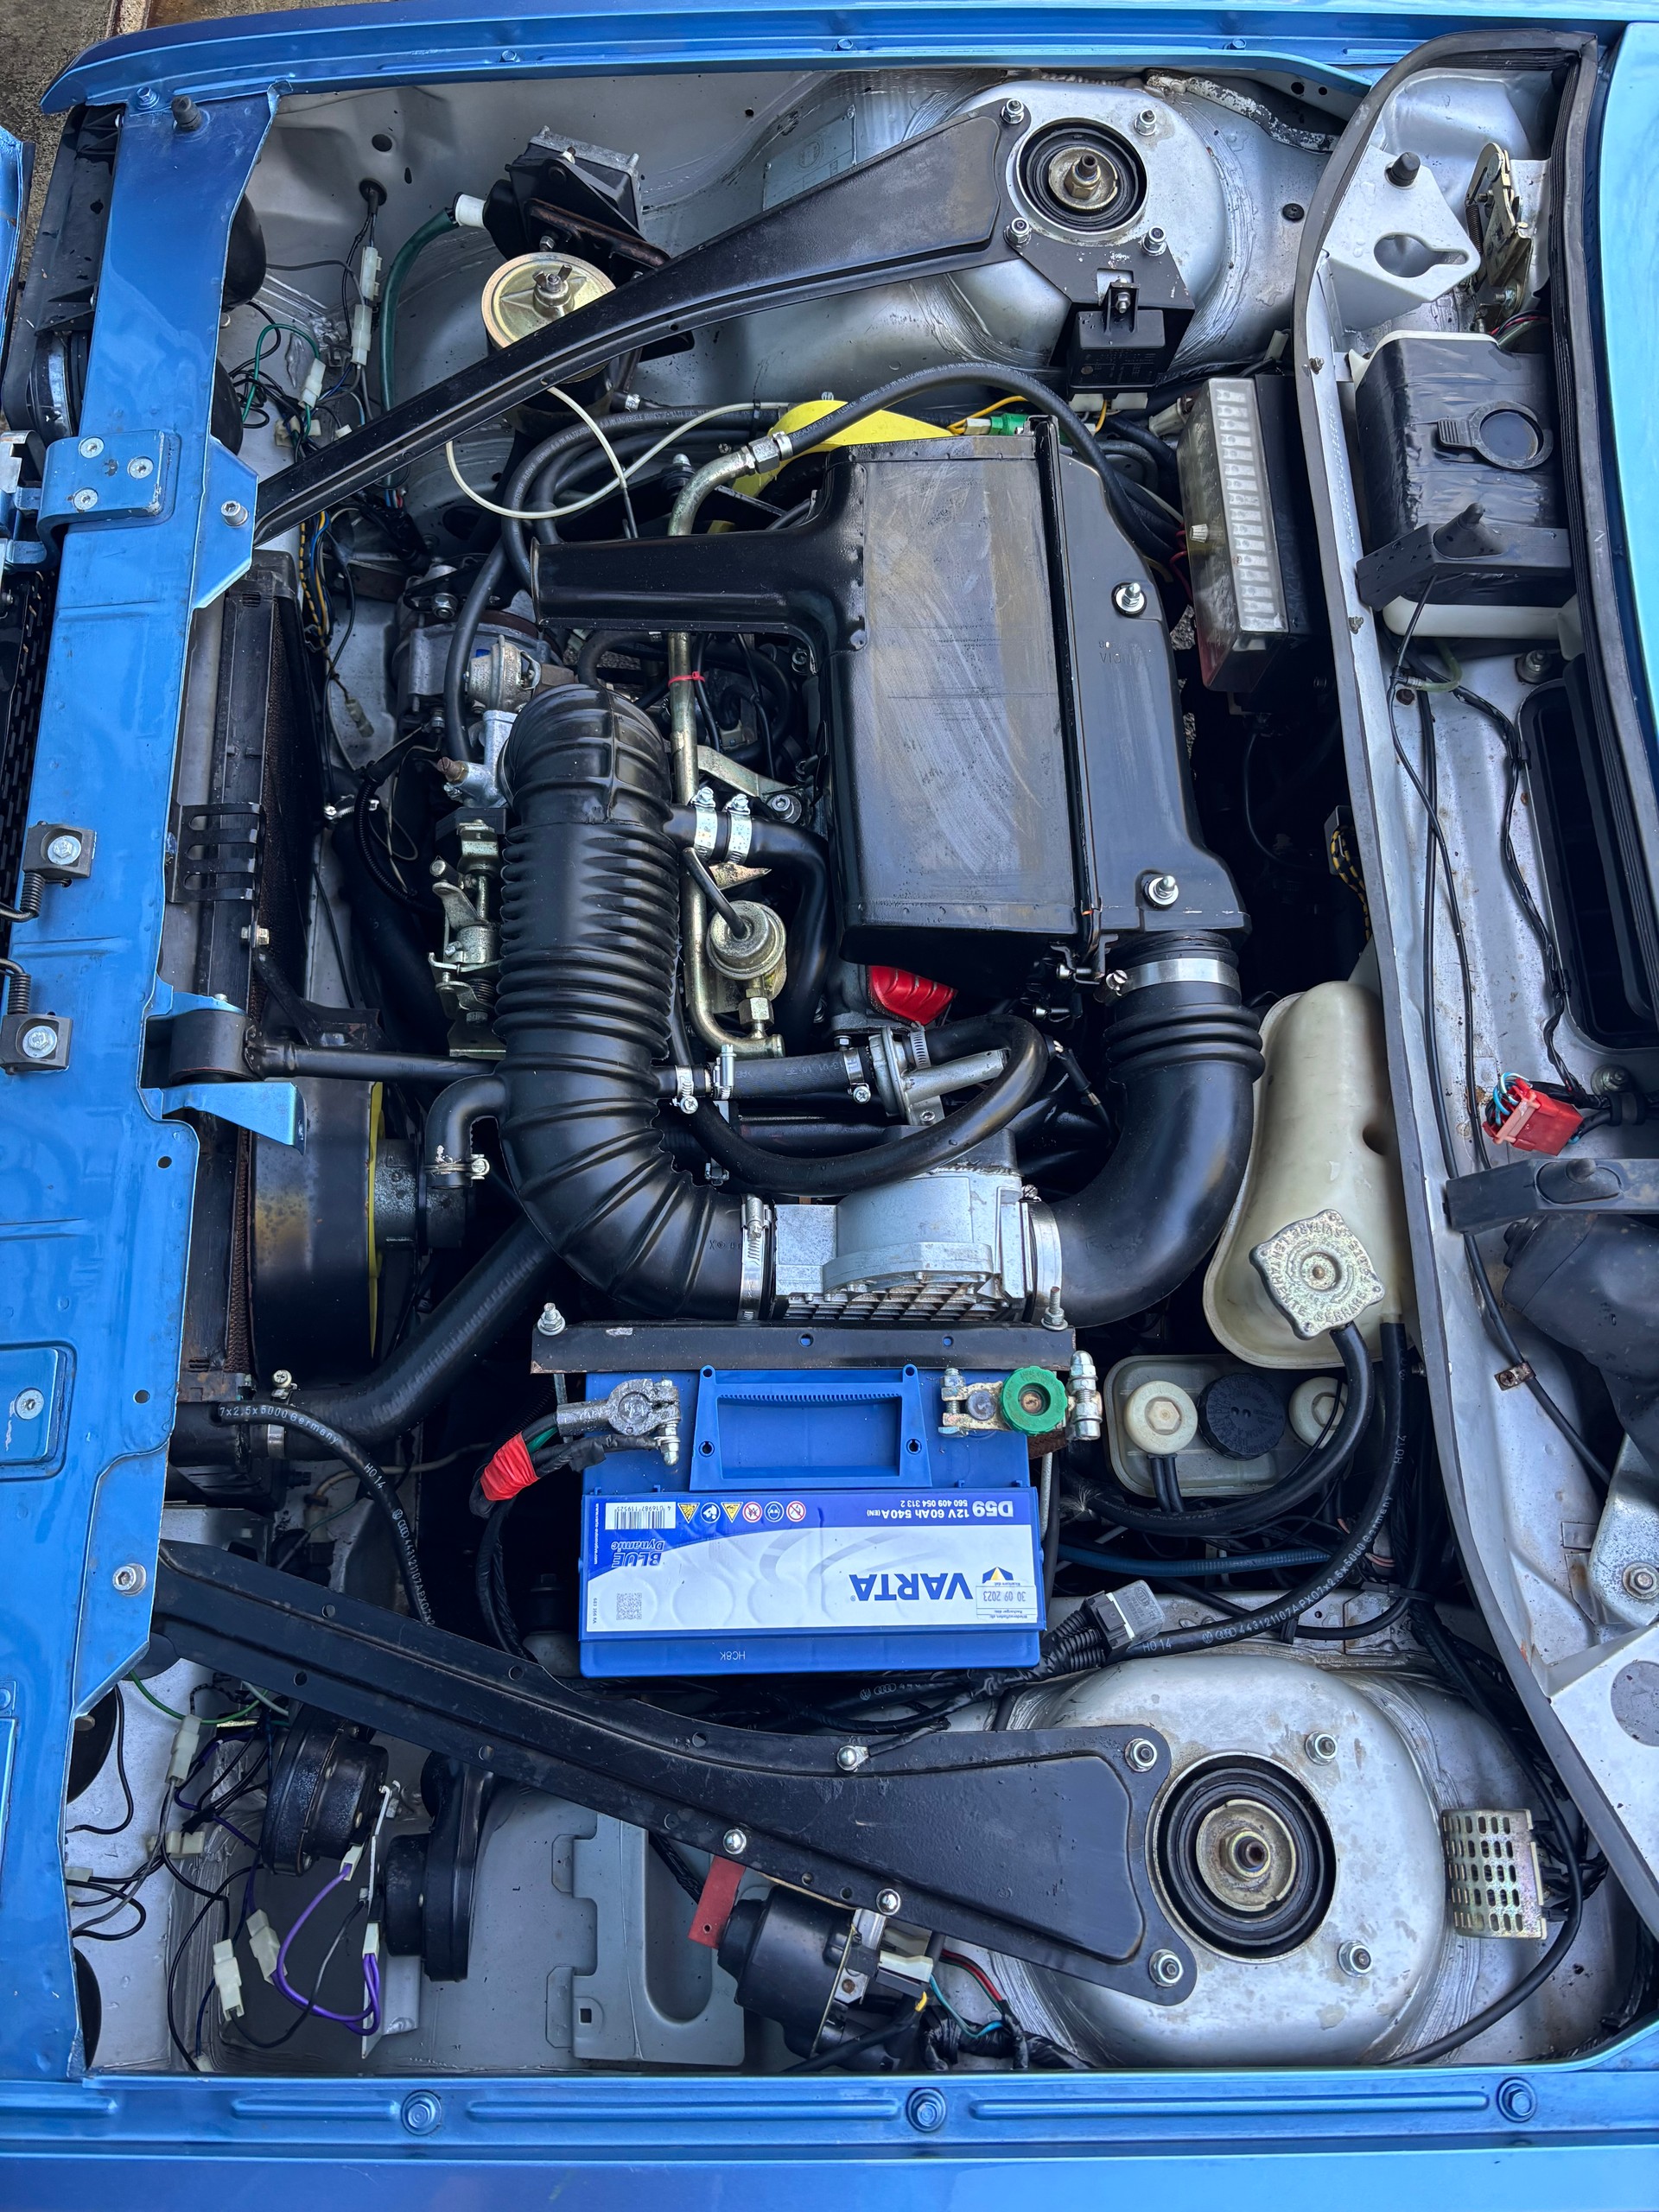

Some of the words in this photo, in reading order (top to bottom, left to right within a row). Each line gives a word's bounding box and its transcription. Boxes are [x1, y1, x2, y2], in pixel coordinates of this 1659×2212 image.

[289, 1411, 340, 1446] Germany
[906, 1499, 920, 1508] 313
[921, 1498, 936, 1507] 054
[936, 1498, 952, 1507] 409
[952, 1498, 968, 1507] 560
[971, 1499, 1014, 1516] D59
[947, 1508, 969, 1517] 12V
[609, 1537, 664, 1552] Dynamic
[610, 1550, 662, 1567] BLUE
[849, 1573, 974, 1601] VARTA
[982, 1590, 1001, 1601] 2023
[1003, 1590, 1013, 1601] 09
[1016, 1590, 1026, 1602] 30
